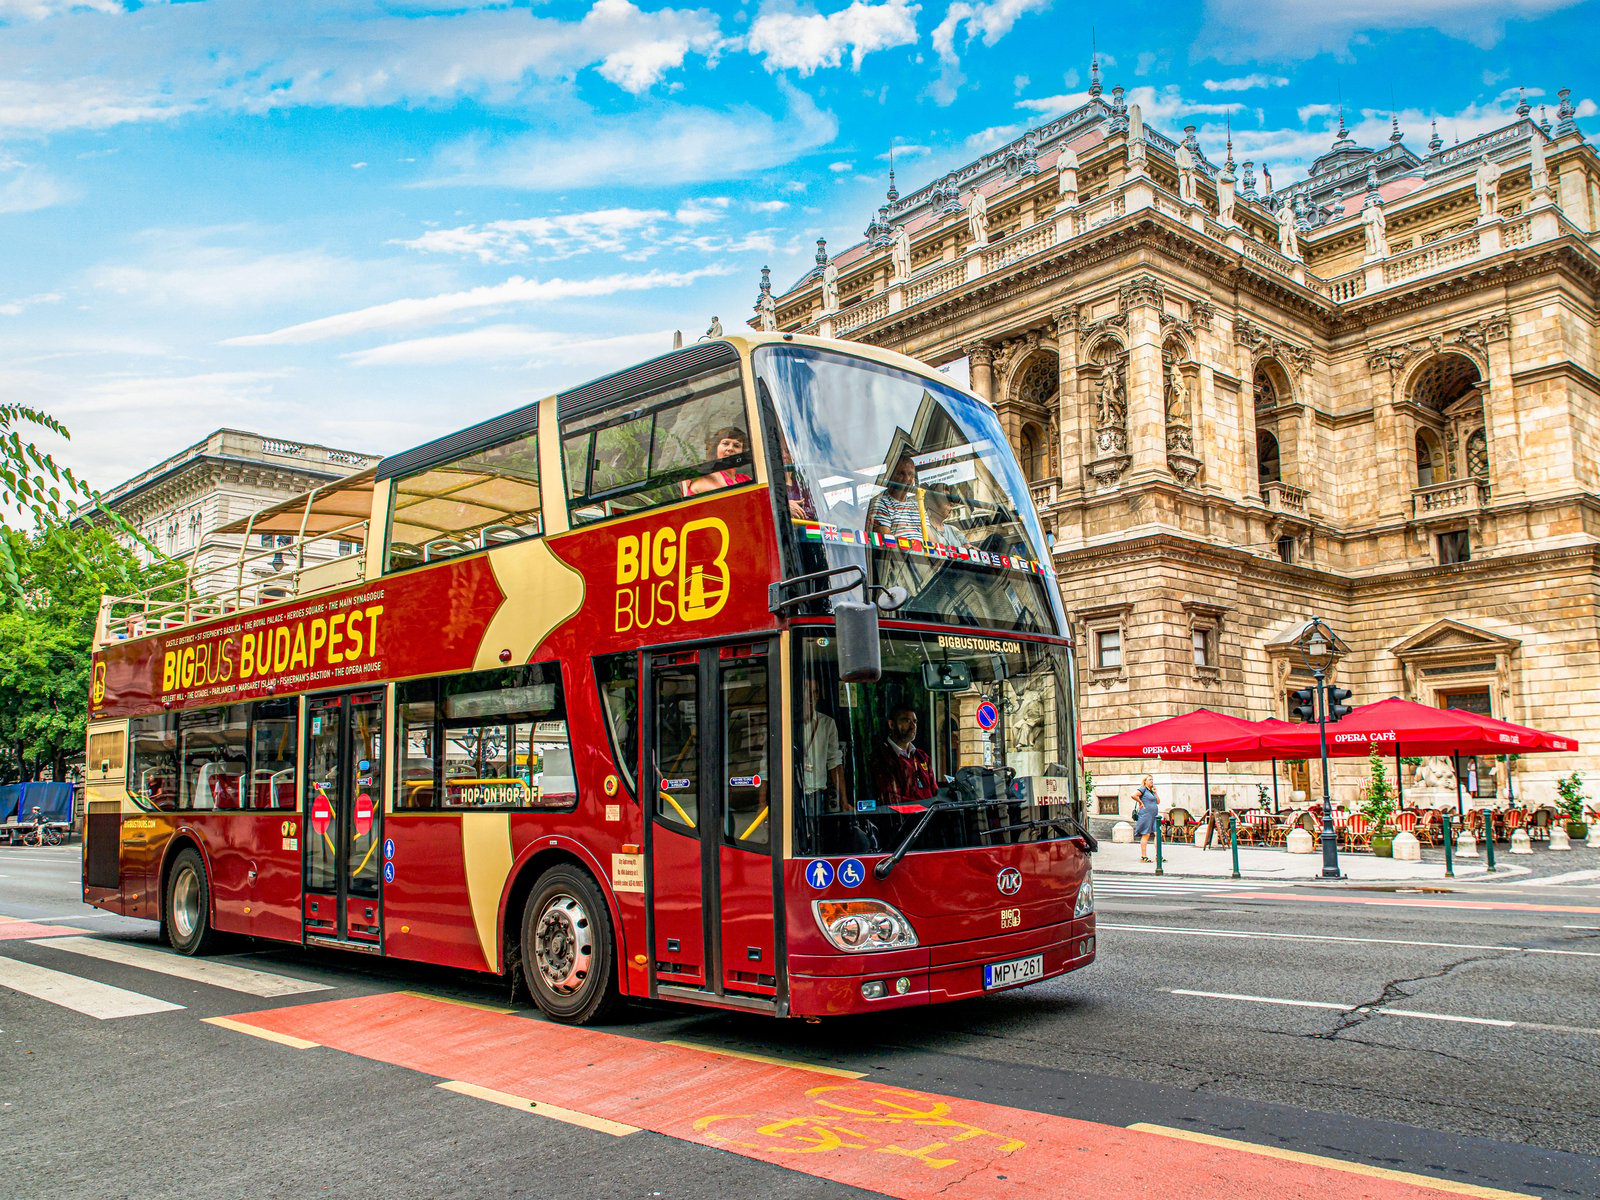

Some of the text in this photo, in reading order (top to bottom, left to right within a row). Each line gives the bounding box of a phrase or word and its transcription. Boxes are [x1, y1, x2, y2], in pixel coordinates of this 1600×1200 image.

[616, 526, 677, 585] BIG
[615, 580, 676, 633] BUS
[165, 639, 179, 647] CASTLE
[179, 635, 195, 645] DISTRICT
[202, 627, 223, 639] STEPHEN'S
[223, 624, 242, 634] BASILICA
[244, 619, 253, 628] THE
[253, 616, 267, 626] ROYAL
[267, 613, 284, 624] PALACE
[286, 609, 305, 620] HEROES
[305, 605, 325, 615] SQUARE
[328, 601, 339, 609] THE
[339, 597, 353, 607] MAIN
[353, 589, 385, 605] SYNAGOGUE
[239, 604, 384, 679] BUDAPEST
[937, 635, 1021, 654] BIGBUSTOURS.COM
[194, 688, 210, 698] CITADEL
[212, 684, 236, 695] PARLIAMENT
[238, 680, 261, 691] MARGARET
[261, 677, 277, 687] ISLAND
[279, 673, 310, 684] FISHERMAN'S
[310, 669, 331, 680] BASTION
[335, 666, 345, 676] THE
[345, 664, 363, 675] OPERA
[363, 661, 382, 672] HOUSE
[1335, 734, 1368, 742] OPERA
[1142, 746, 1169, 754] OPERA
[461, 786, 545, 803] HOP-ON HOP-OFF
[124, 819, 156, 829] BIGBUSTOURS.COM
[1001, 909, 1012, 920] BIG
[1001, 919, 1013, 929] BUS
[994, 957, 1041, 983] MPY-261
